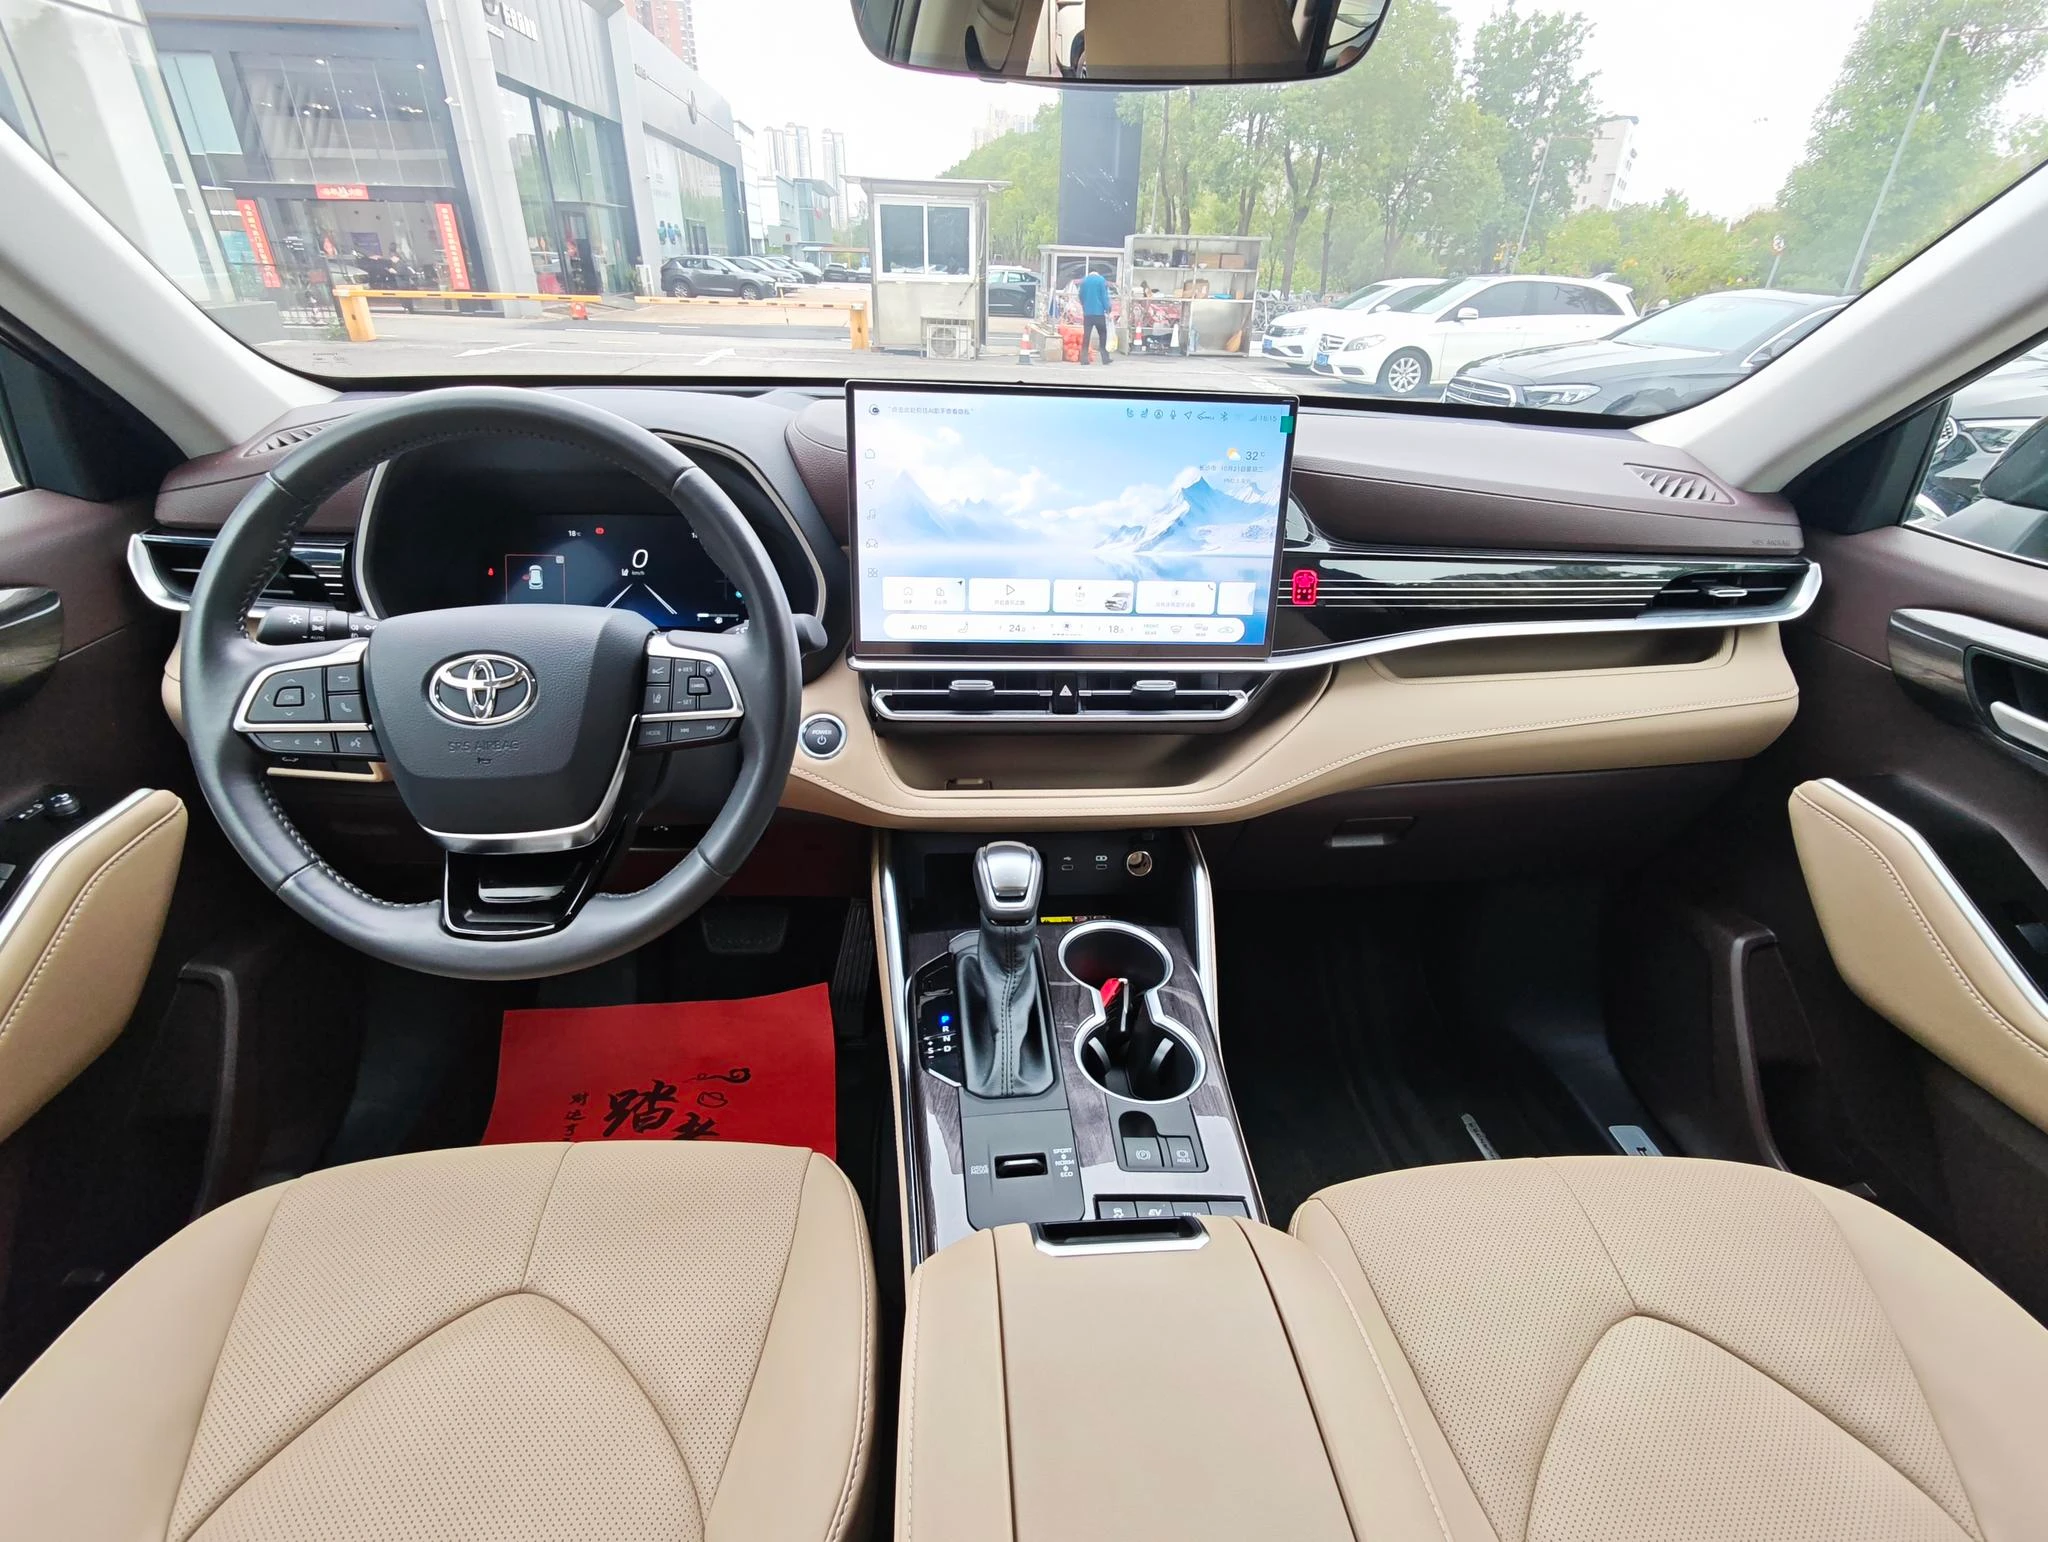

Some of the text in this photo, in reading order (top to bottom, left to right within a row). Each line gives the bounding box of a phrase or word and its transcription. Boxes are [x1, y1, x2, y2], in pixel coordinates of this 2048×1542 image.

[632, 549, 648, 569] 0
[448, 740, 520, 752] SRS AIRBAG
[941, 1015, 950, 1024] P
[942, 1025, 950, 1033] R
[943, 1034, 952, 1042] N
[927, 1047, 934, 1055] S
[943, 1045, 952, 1053] D
[1053, 1147, 1073, 1155] SPORT
[1054, 1159, 1075, 1167] NORM
